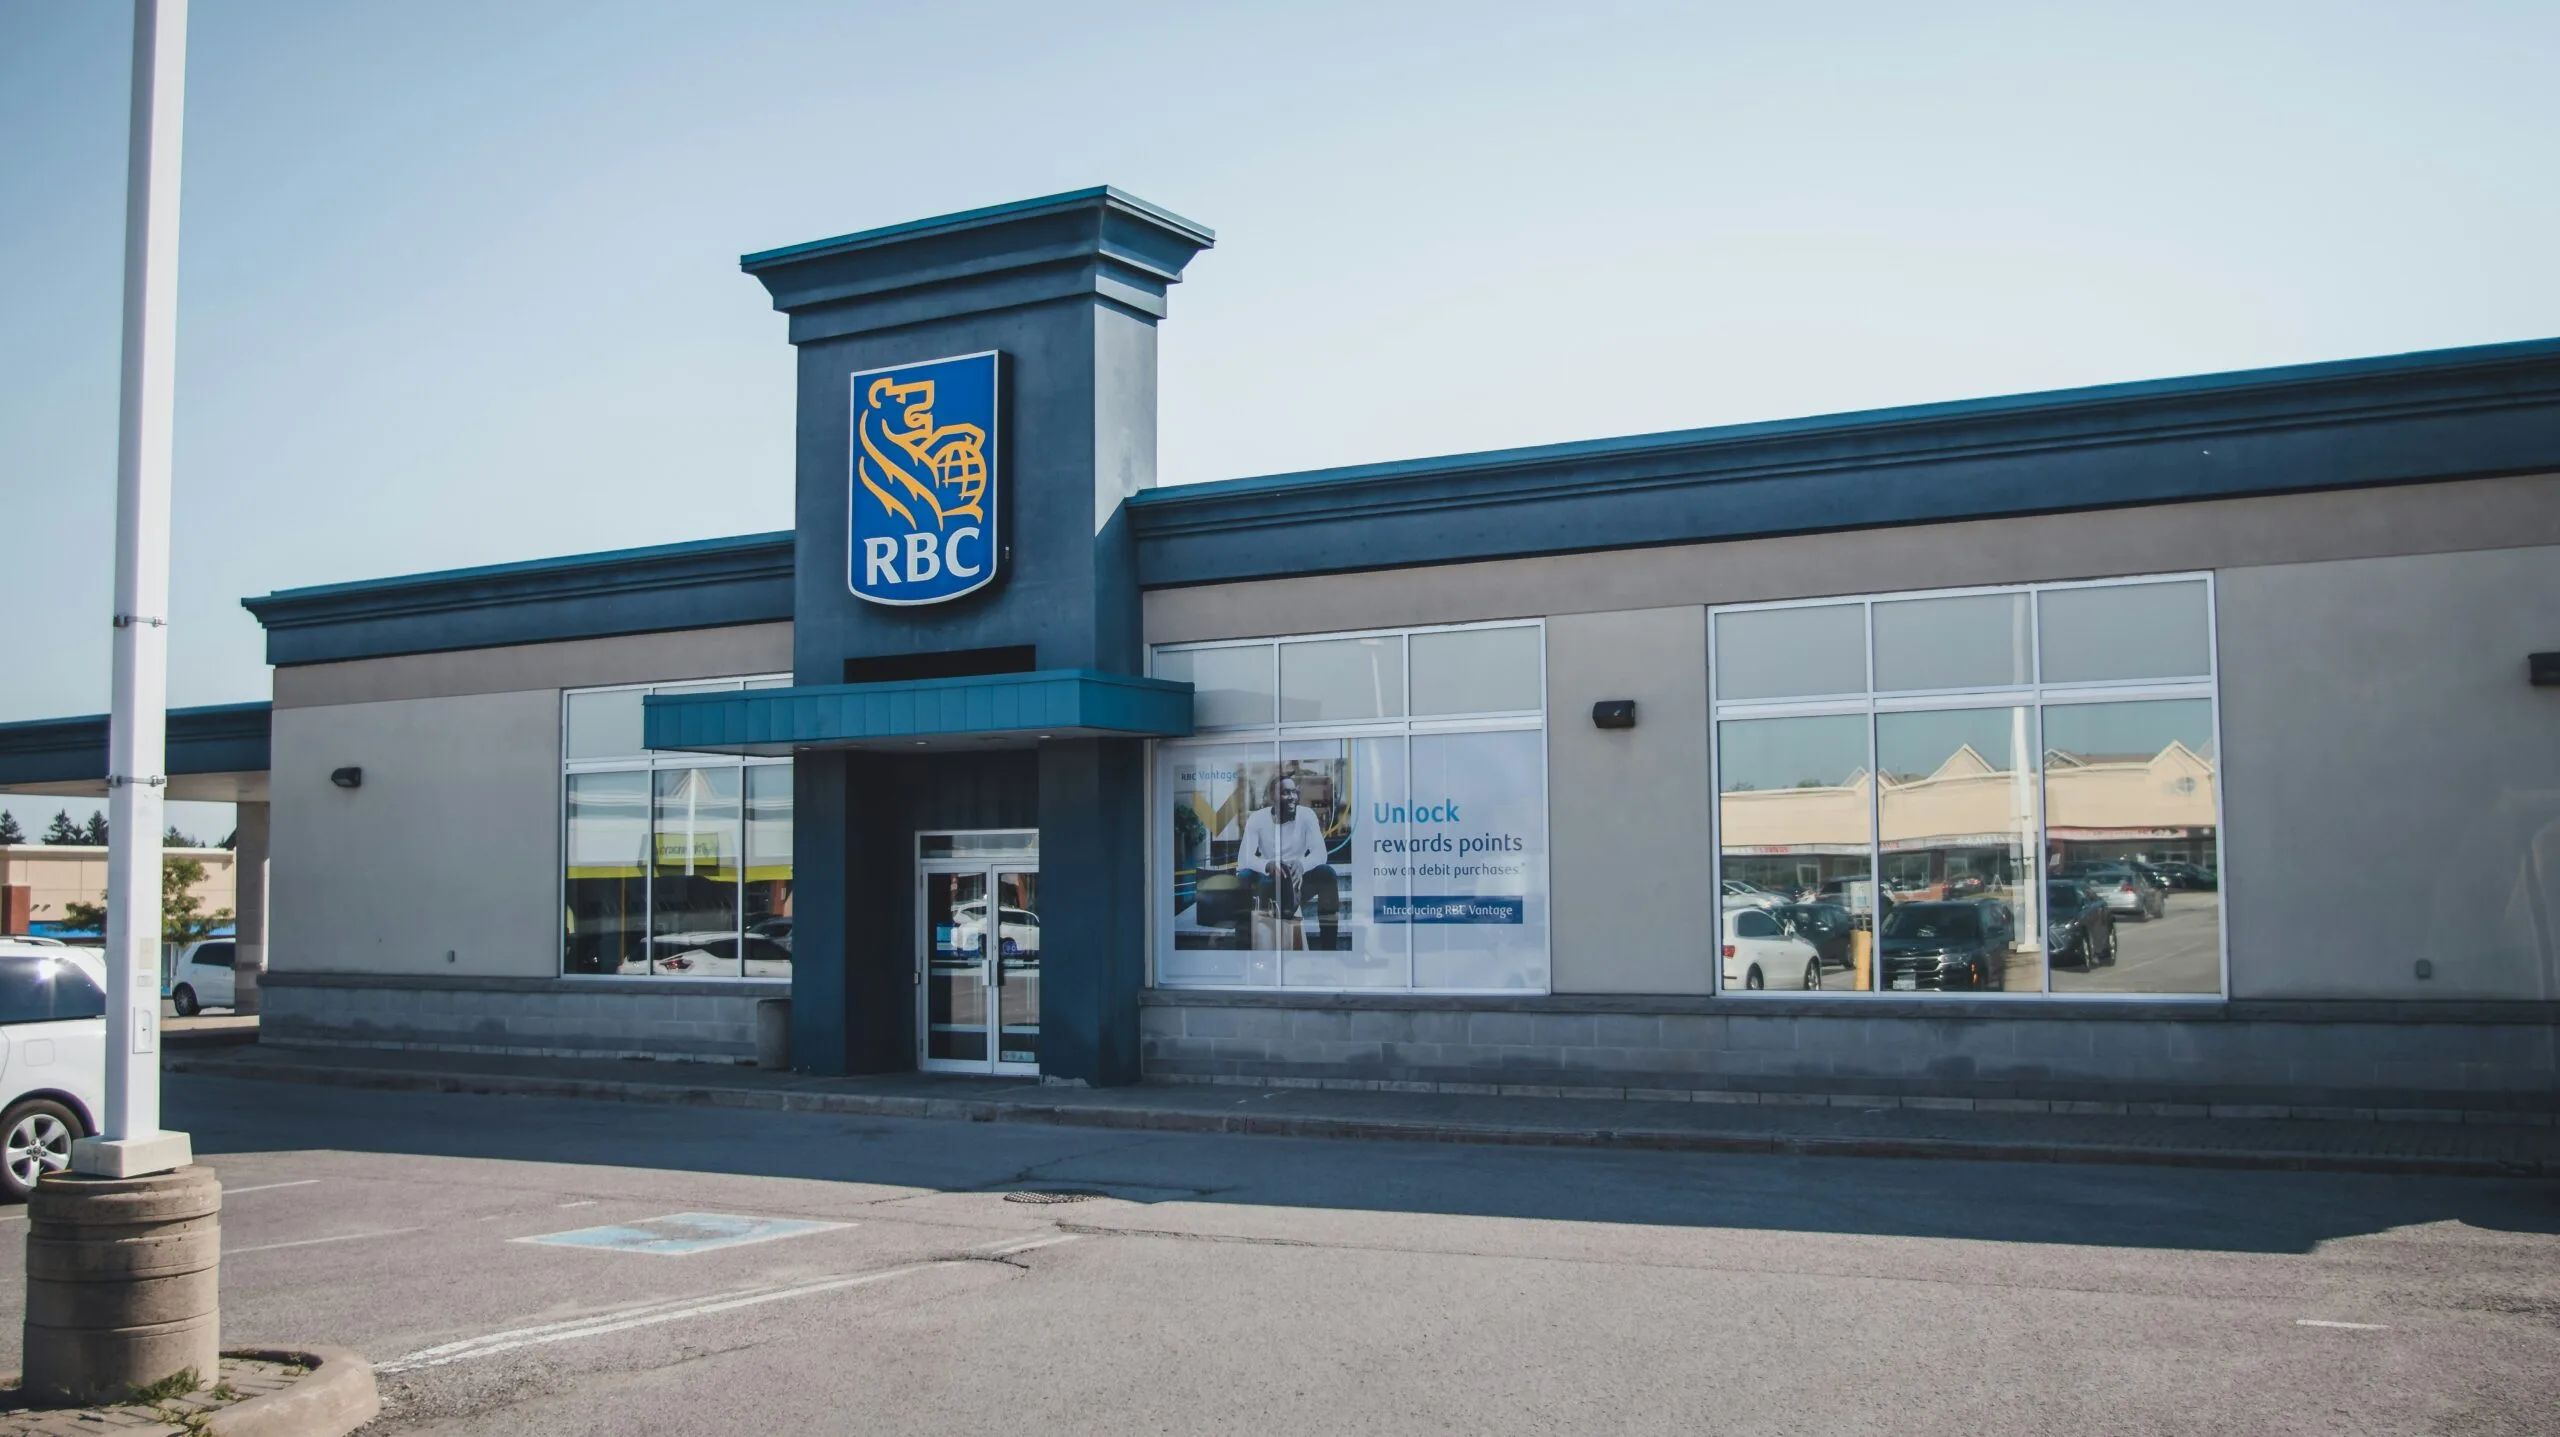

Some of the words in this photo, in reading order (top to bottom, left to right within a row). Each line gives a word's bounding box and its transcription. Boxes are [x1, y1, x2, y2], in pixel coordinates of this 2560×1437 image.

[864, 527, 980, 586] RBC
[1374, 799, 1460, 824] Unlock
[1374, 833, 1453, 853] rewards
[1459, 832, 1523, 857] points
[1373, 866, 1398, 877] now
[1400, 866, 1416, 876] on
[1419, 863, 1450, 877] debit
[1383, 904, 1443, 919] Introducing
[1445, 905, 1467, 916] RBC
[1469, 905, 1513, 919] Vantage
